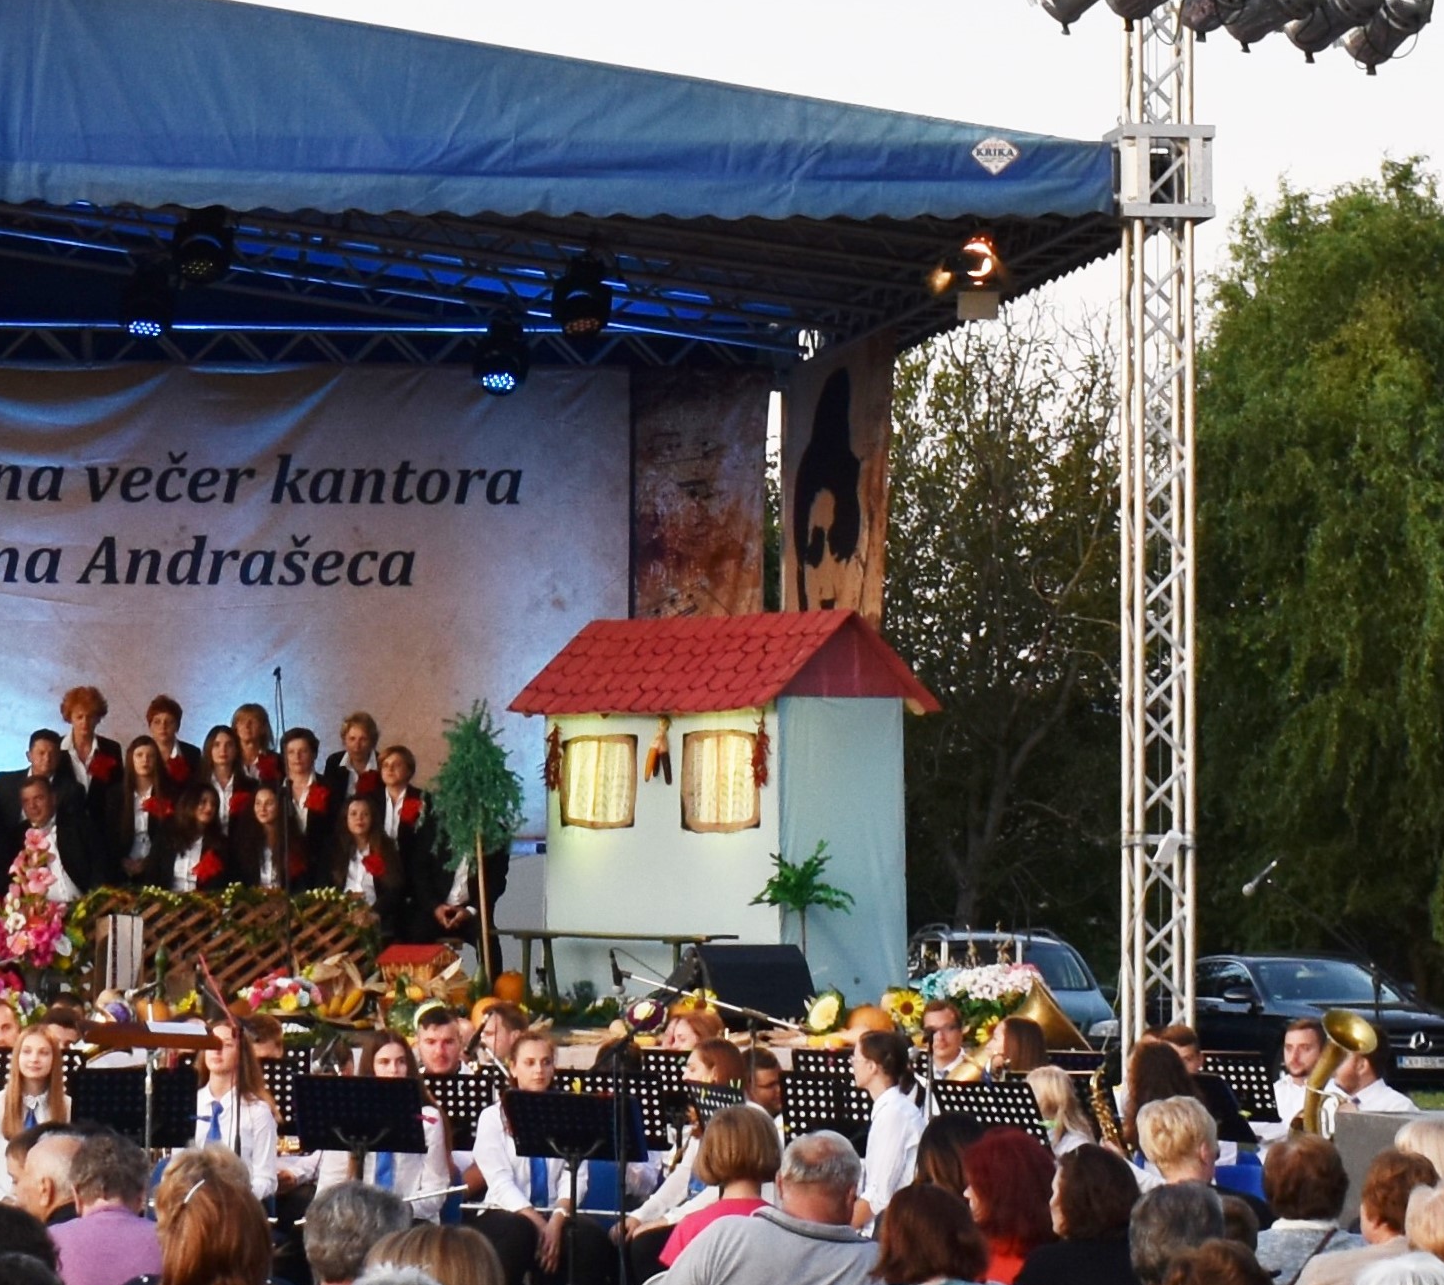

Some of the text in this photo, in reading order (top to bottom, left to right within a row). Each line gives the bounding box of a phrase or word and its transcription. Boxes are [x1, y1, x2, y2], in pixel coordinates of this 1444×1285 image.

[976, 148, 1014, 157] KRIKA
[84, 451, 255, 504] večer
[270, 453, 522, 505] kantora
[76, 534, 415, 587] Andrašeca
